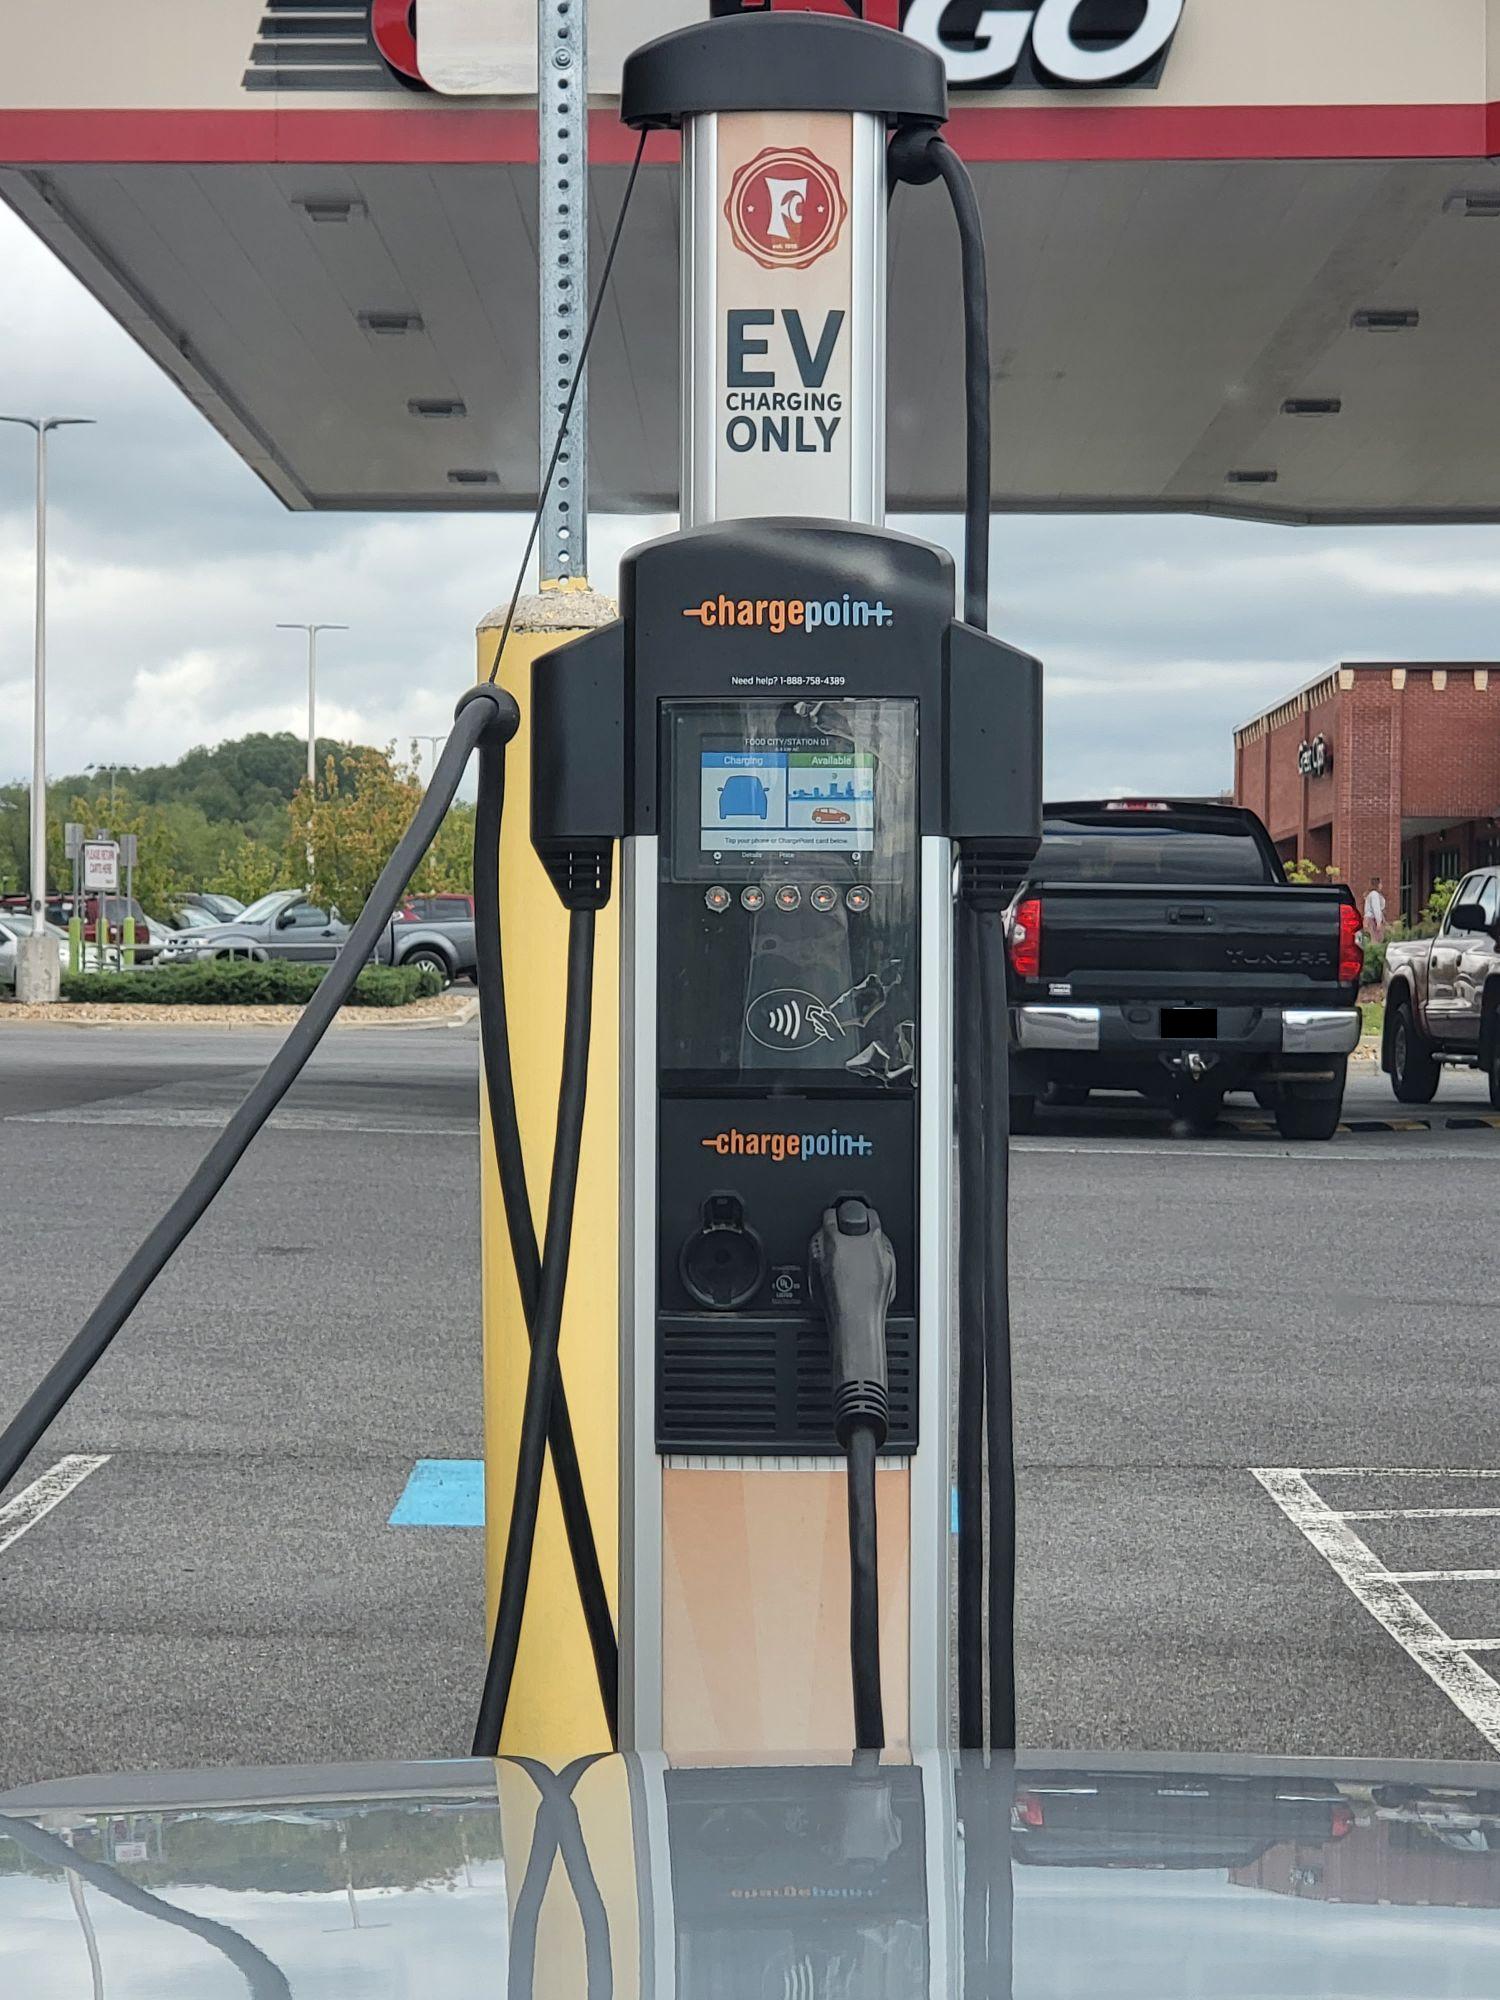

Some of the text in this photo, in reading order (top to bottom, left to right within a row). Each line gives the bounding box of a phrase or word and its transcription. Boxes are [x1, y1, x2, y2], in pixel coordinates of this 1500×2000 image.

[726, 308, 846, 388] EV
[726, 392, 842, 412] CHARGING
[725, 415, 842, 453] ONLY
[731, 676, 845, 687] Need help? 1-888-758-4389
[744, 737, 766, 747] FOOD
[766, 737, 819, 747] CITY/STATION
[723, 755, 764, 767] Charging
[811, 755, 852, 766] Available
